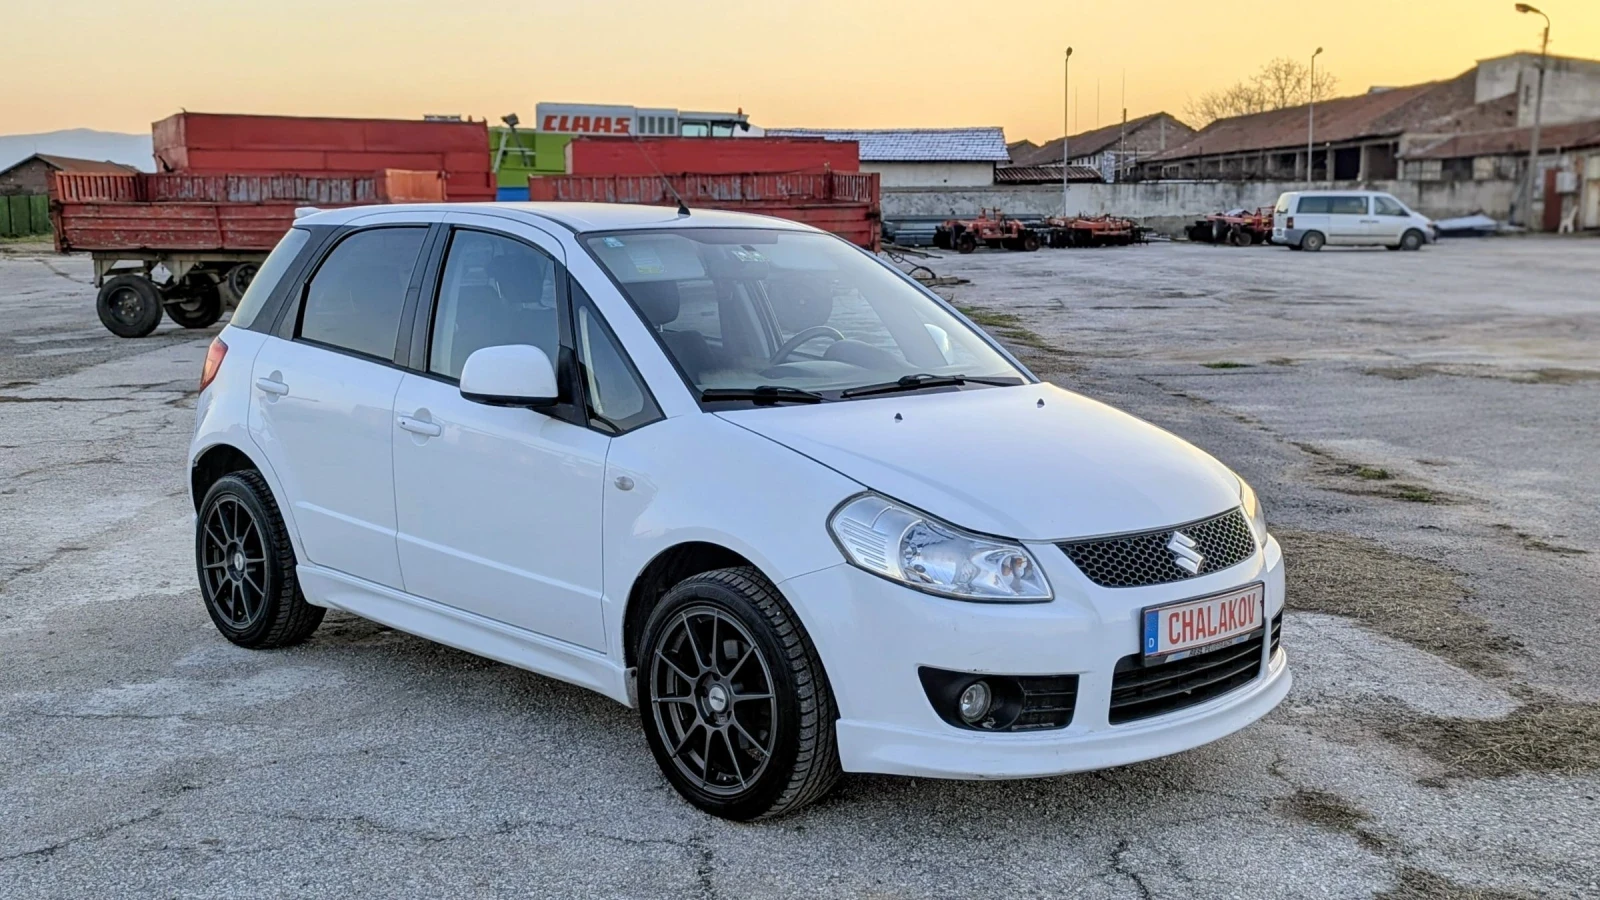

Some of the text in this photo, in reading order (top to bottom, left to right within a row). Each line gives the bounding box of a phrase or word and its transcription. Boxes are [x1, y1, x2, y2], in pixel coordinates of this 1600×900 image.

[543, 115, 631, 133] CLAAS
[1148, 593, 1256, 648] D CHALAKOV
